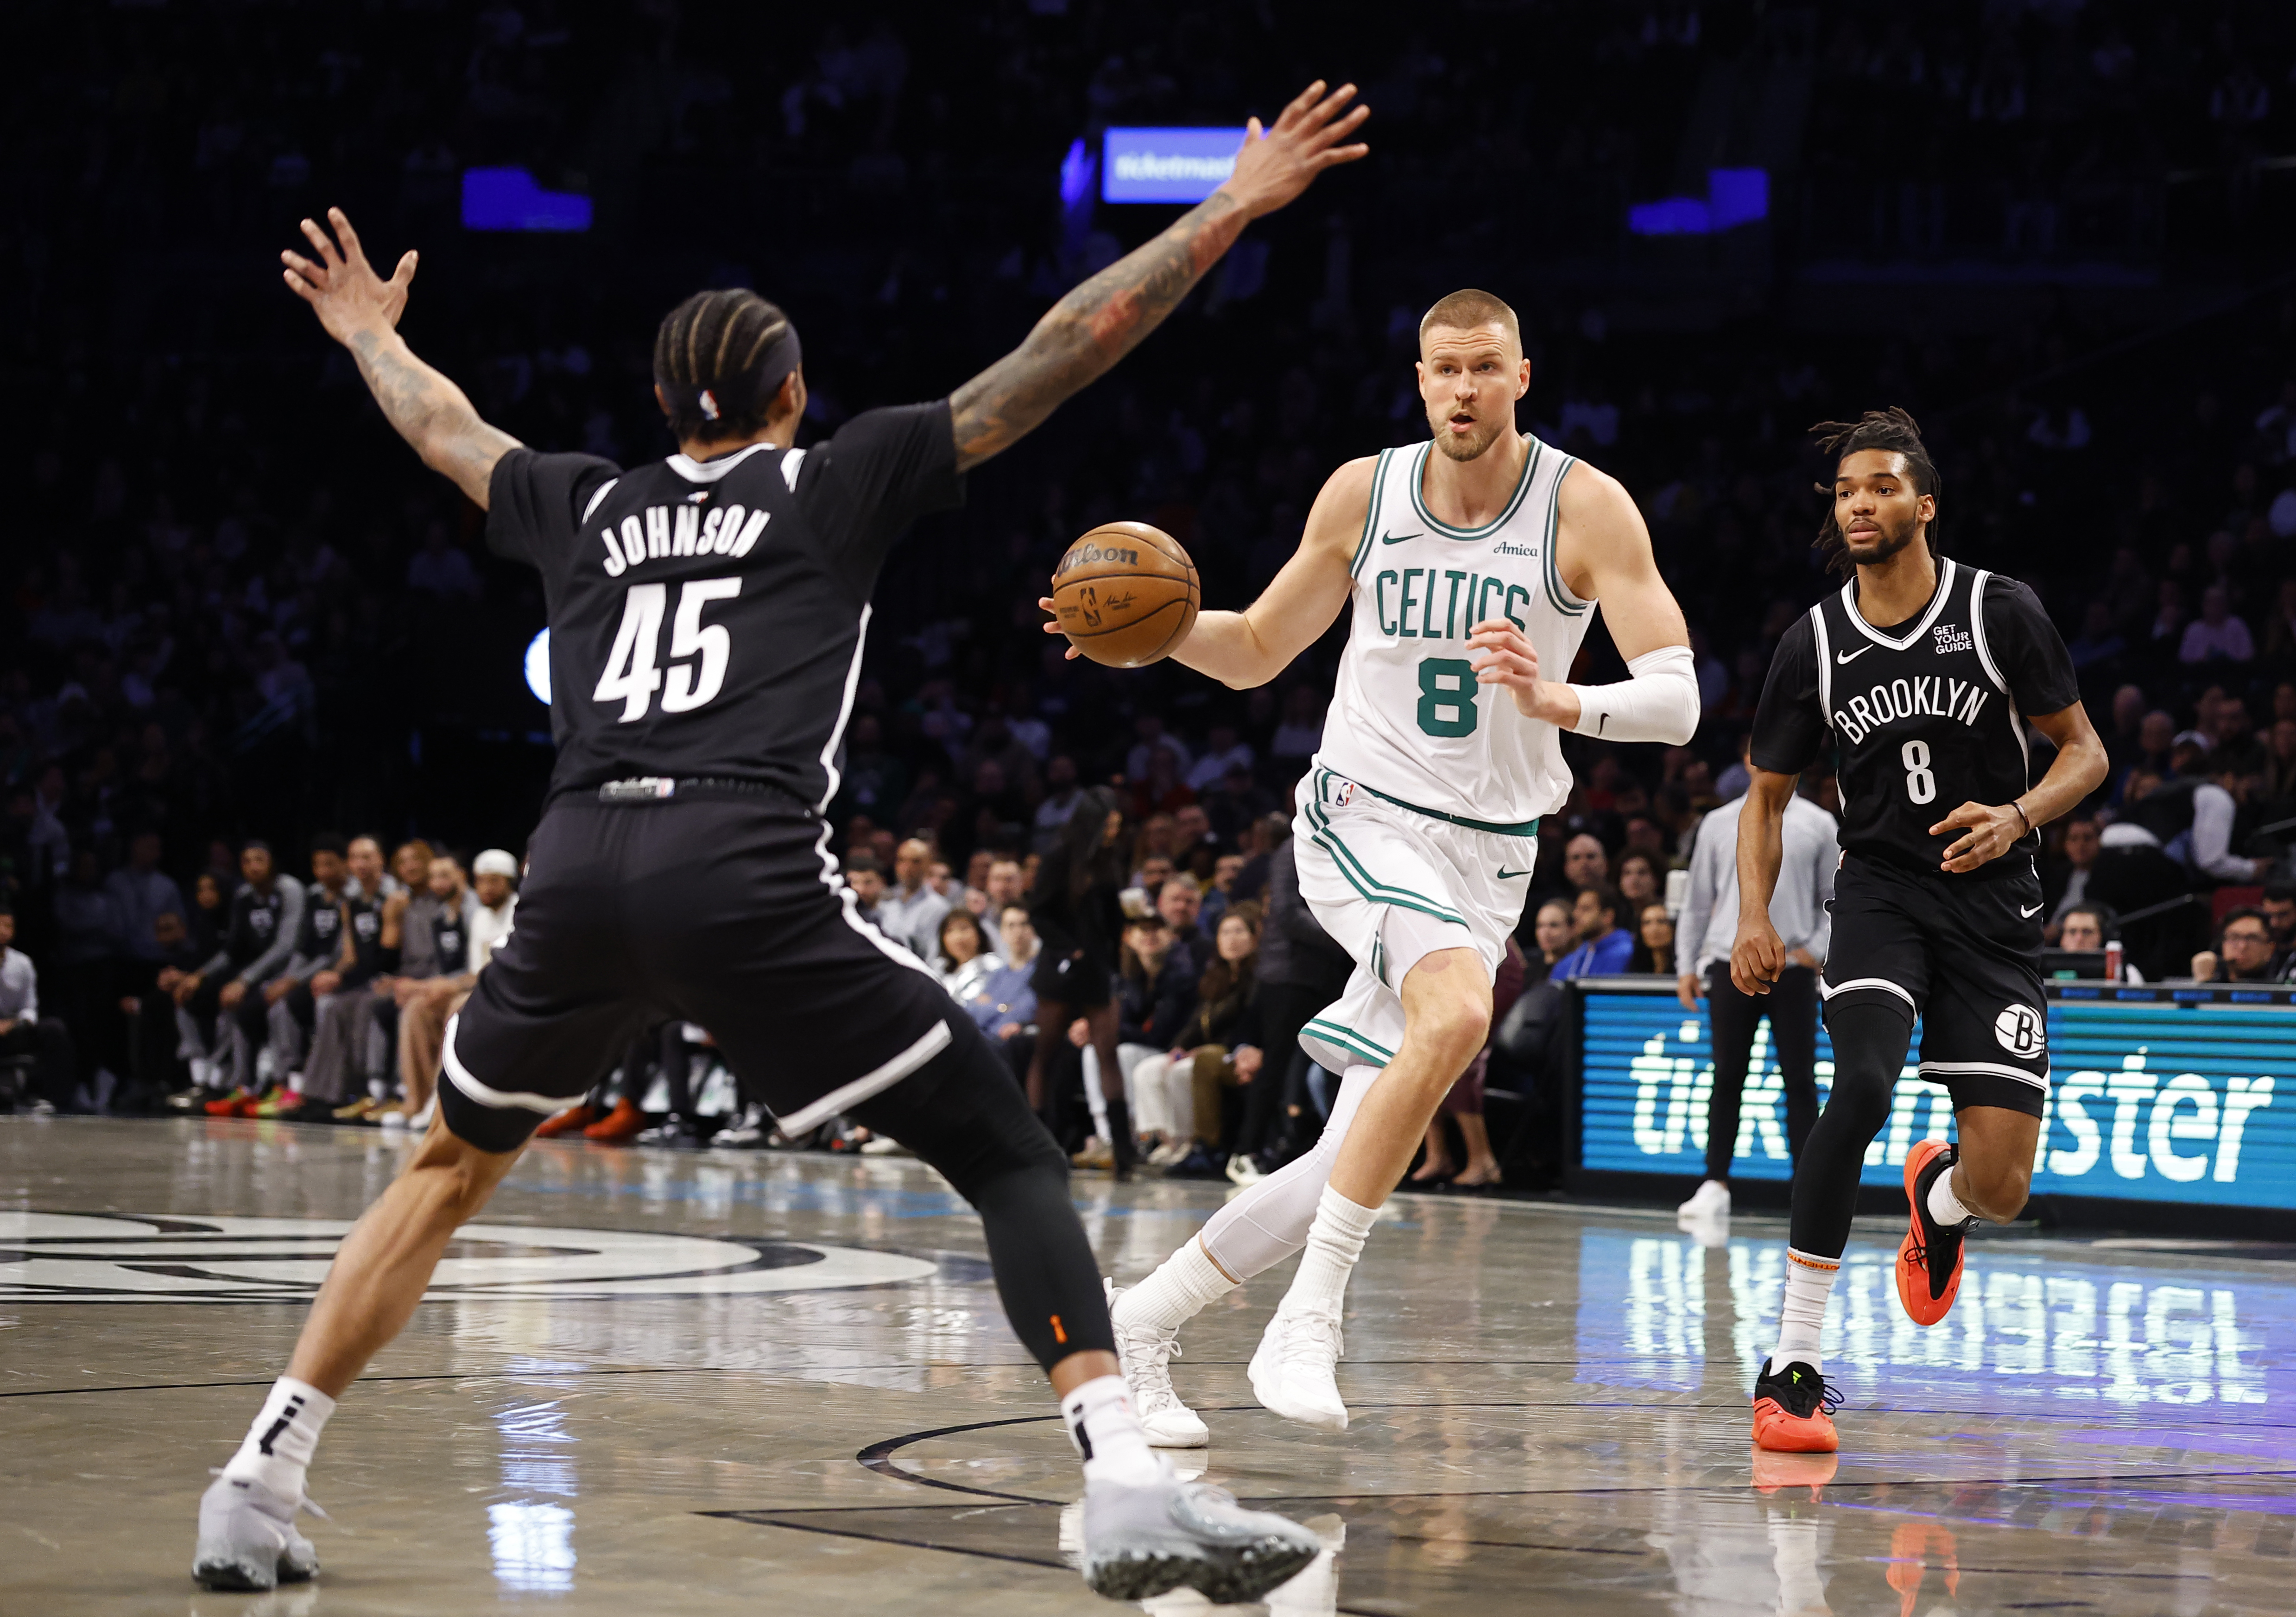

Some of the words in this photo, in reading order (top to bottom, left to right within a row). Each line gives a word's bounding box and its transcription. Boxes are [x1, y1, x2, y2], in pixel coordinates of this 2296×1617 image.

[601, 504, 771, 577] JOHNSON
[1493, 541, 1537, 557] Amica
[1376, 568, 1530, 640] CELTICS
[1933, 624, 1955, 636] GET
[592, 576, 743, 723] 45
[1934, 632, 1969, 644] YOUR
[1935, 640, 1973, 654] GUIDE
[1417, 657, 1478, 738] 8
[1834, 676, 1988, 745] BROOKLYN
[1901, 740, 1936, 805] 8
[2014, 1011, 2034, 1051] B
